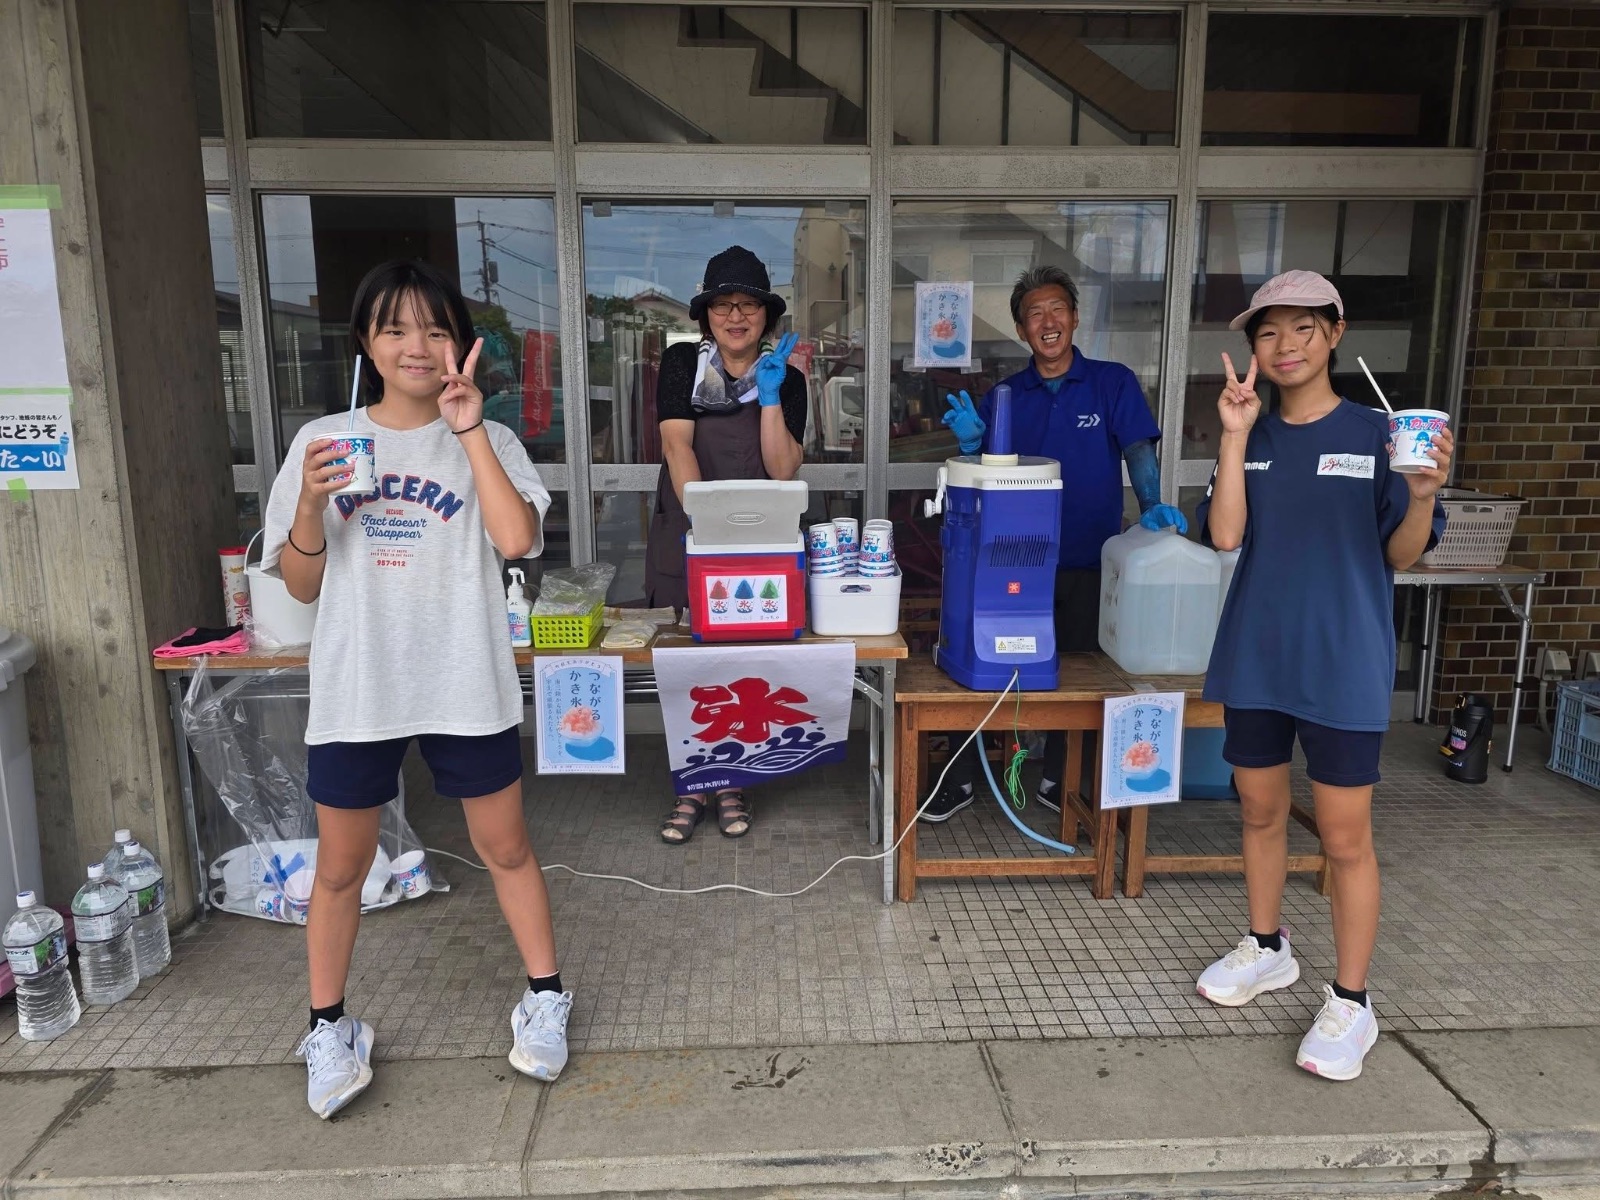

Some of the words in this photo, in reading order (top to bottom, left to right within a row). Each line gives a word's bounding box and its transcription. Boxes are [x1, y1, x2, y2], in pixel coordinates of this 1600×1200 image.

[951, 294, 959, 330] つながる
[1244, 460, 1271, 470] mmel
[361, 514, 387, 526] Fact
[388, 517, 427, 528] doesn't
[365, 526, 422, 541] Disappear
[376, 559, 406, 567] 957-012
[588, 672, 601, 721] つながる
[689, 677, 820, 743] 氷
[1150, 708, 1162, 754] つながる
